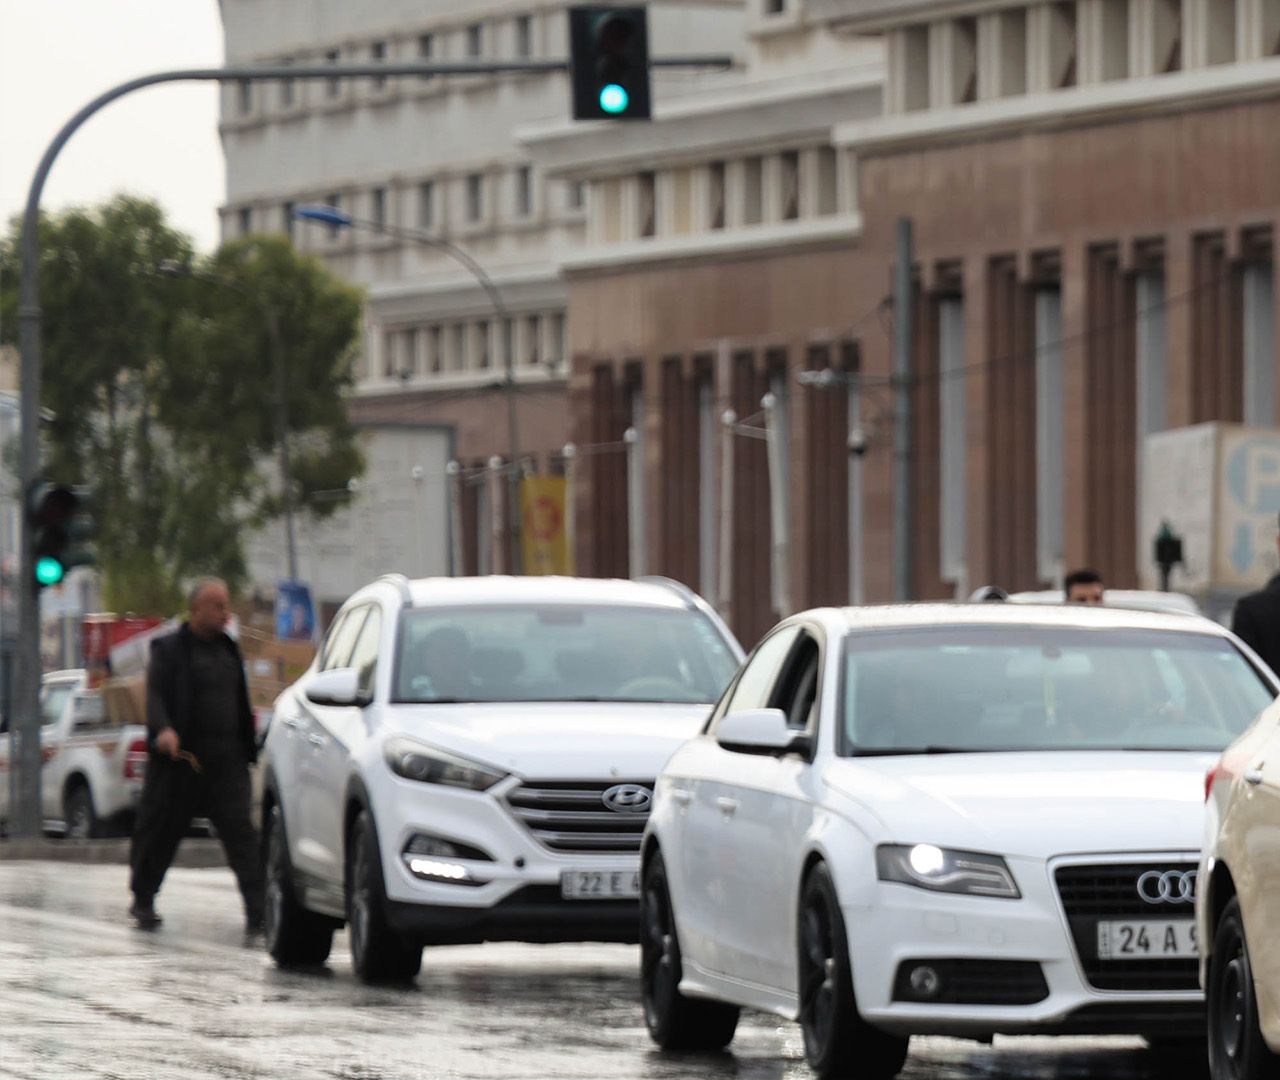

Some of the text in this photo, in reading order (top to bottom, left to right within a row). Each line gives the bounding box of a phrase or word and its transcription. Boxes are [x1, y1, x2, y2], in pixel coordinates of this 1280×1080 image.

[579, 872, 601, 892] 22
[1119, 925, 1150, 953] 24
[1163, 926, 1177, 952] A
